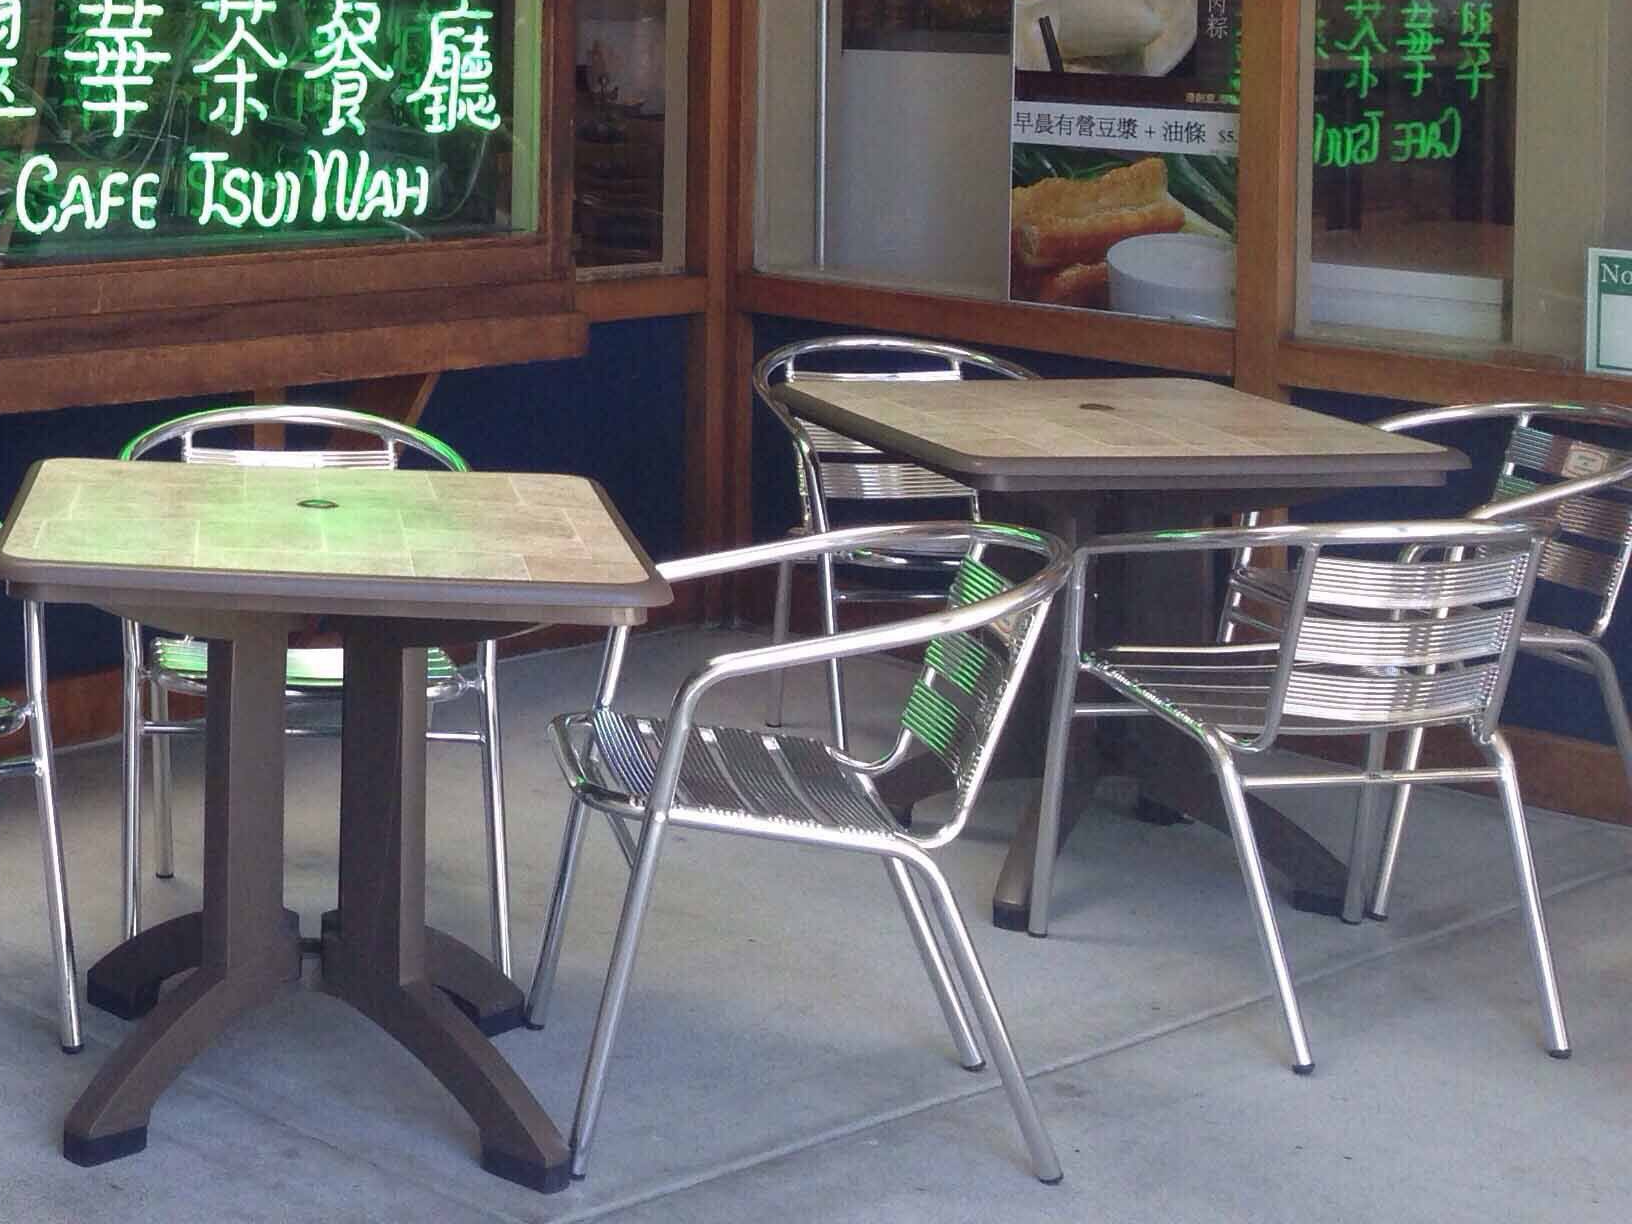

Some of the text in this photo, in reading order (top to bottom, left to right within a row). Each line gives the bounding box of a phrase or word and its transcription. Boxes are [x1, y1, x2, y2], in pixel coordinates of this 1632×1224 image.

[1013, 110, 1139, 141] 早晨有營豆漿
[1163, 119, 1207, 145] 油條
[16, 149, 430, 234] CAFE TSUI WAH
